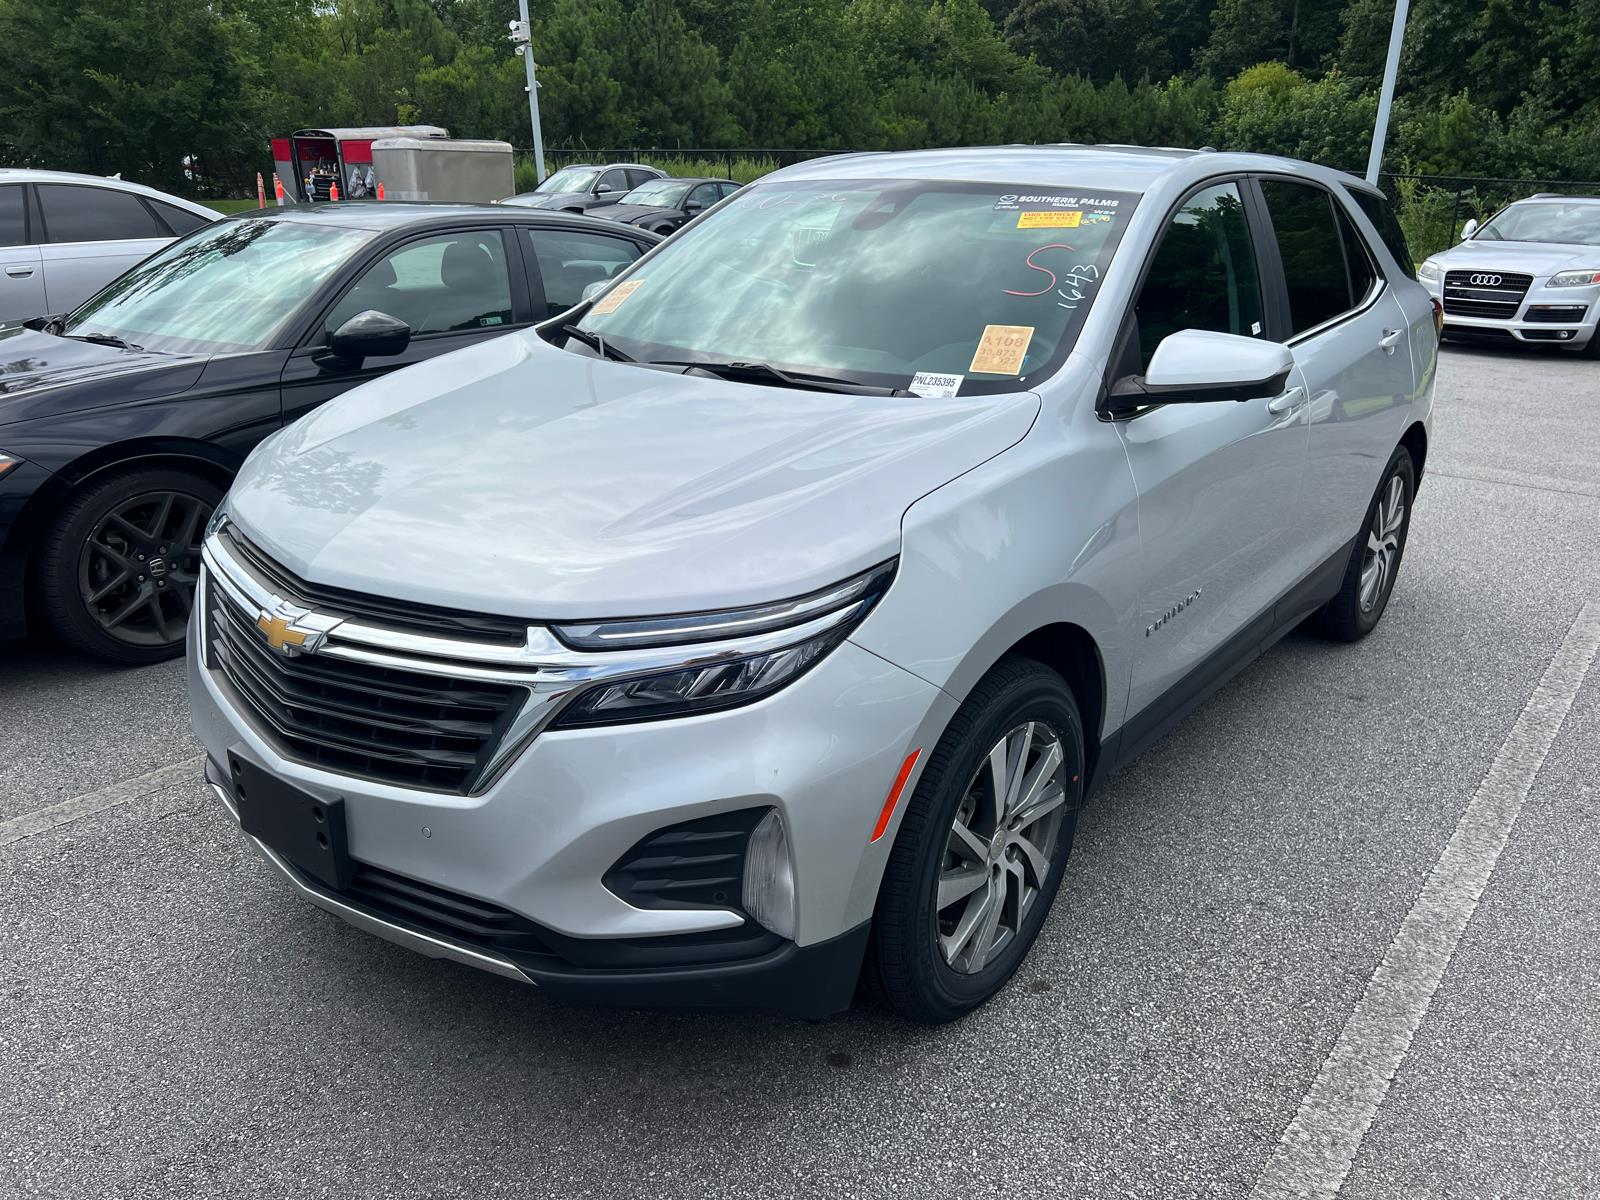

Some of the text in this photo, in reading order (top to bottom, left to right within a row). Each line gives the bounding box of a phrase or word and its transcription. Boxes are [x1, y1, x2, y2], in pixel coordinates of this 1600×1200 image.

[1018, 195, 1120, 207] SOUTHERN PALMS
[913, 375, 957, 388] PNL235395
